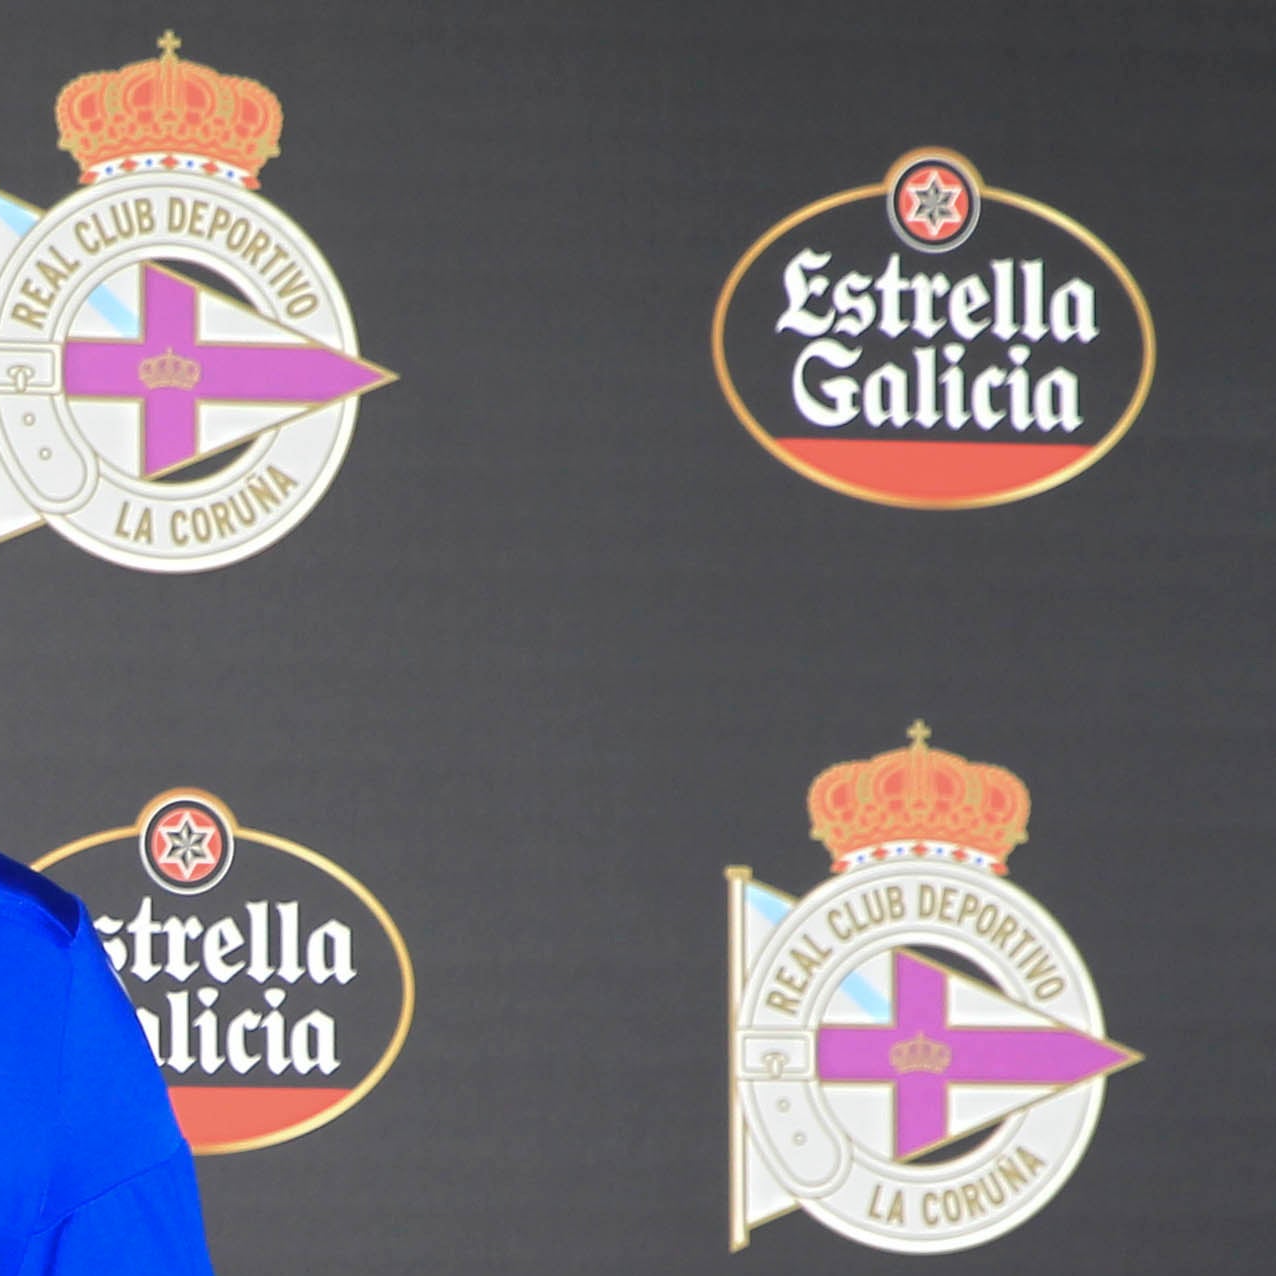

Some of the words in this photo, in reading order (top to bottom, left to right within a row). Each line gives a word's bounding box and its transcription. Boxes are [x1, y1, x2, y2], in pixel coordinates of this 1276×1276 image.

[10, 246, 81, 331] REAL
[73, 197, 155, 255] CLUB
[167, 196, 320, 319] DEPORTIVO
[775, 249, 1099, 343] Estrella
[792, 338, 1083, 432] Galicia
[114, 500, 154, 546] LA
[169, 463, 300, 547] CORUÑA
[93, 896, 357, 985] strella
[766, 933, 834, 1018] REAL
[826, 884, 907, 941] CLUB
[918, 883, 1067, 1003] DEPORTIVO
[136, 986, 341, 1075] licia
[867, 1184, 905, 1227] LA
[920, 1145, 1046, 1228] CORUÑA
